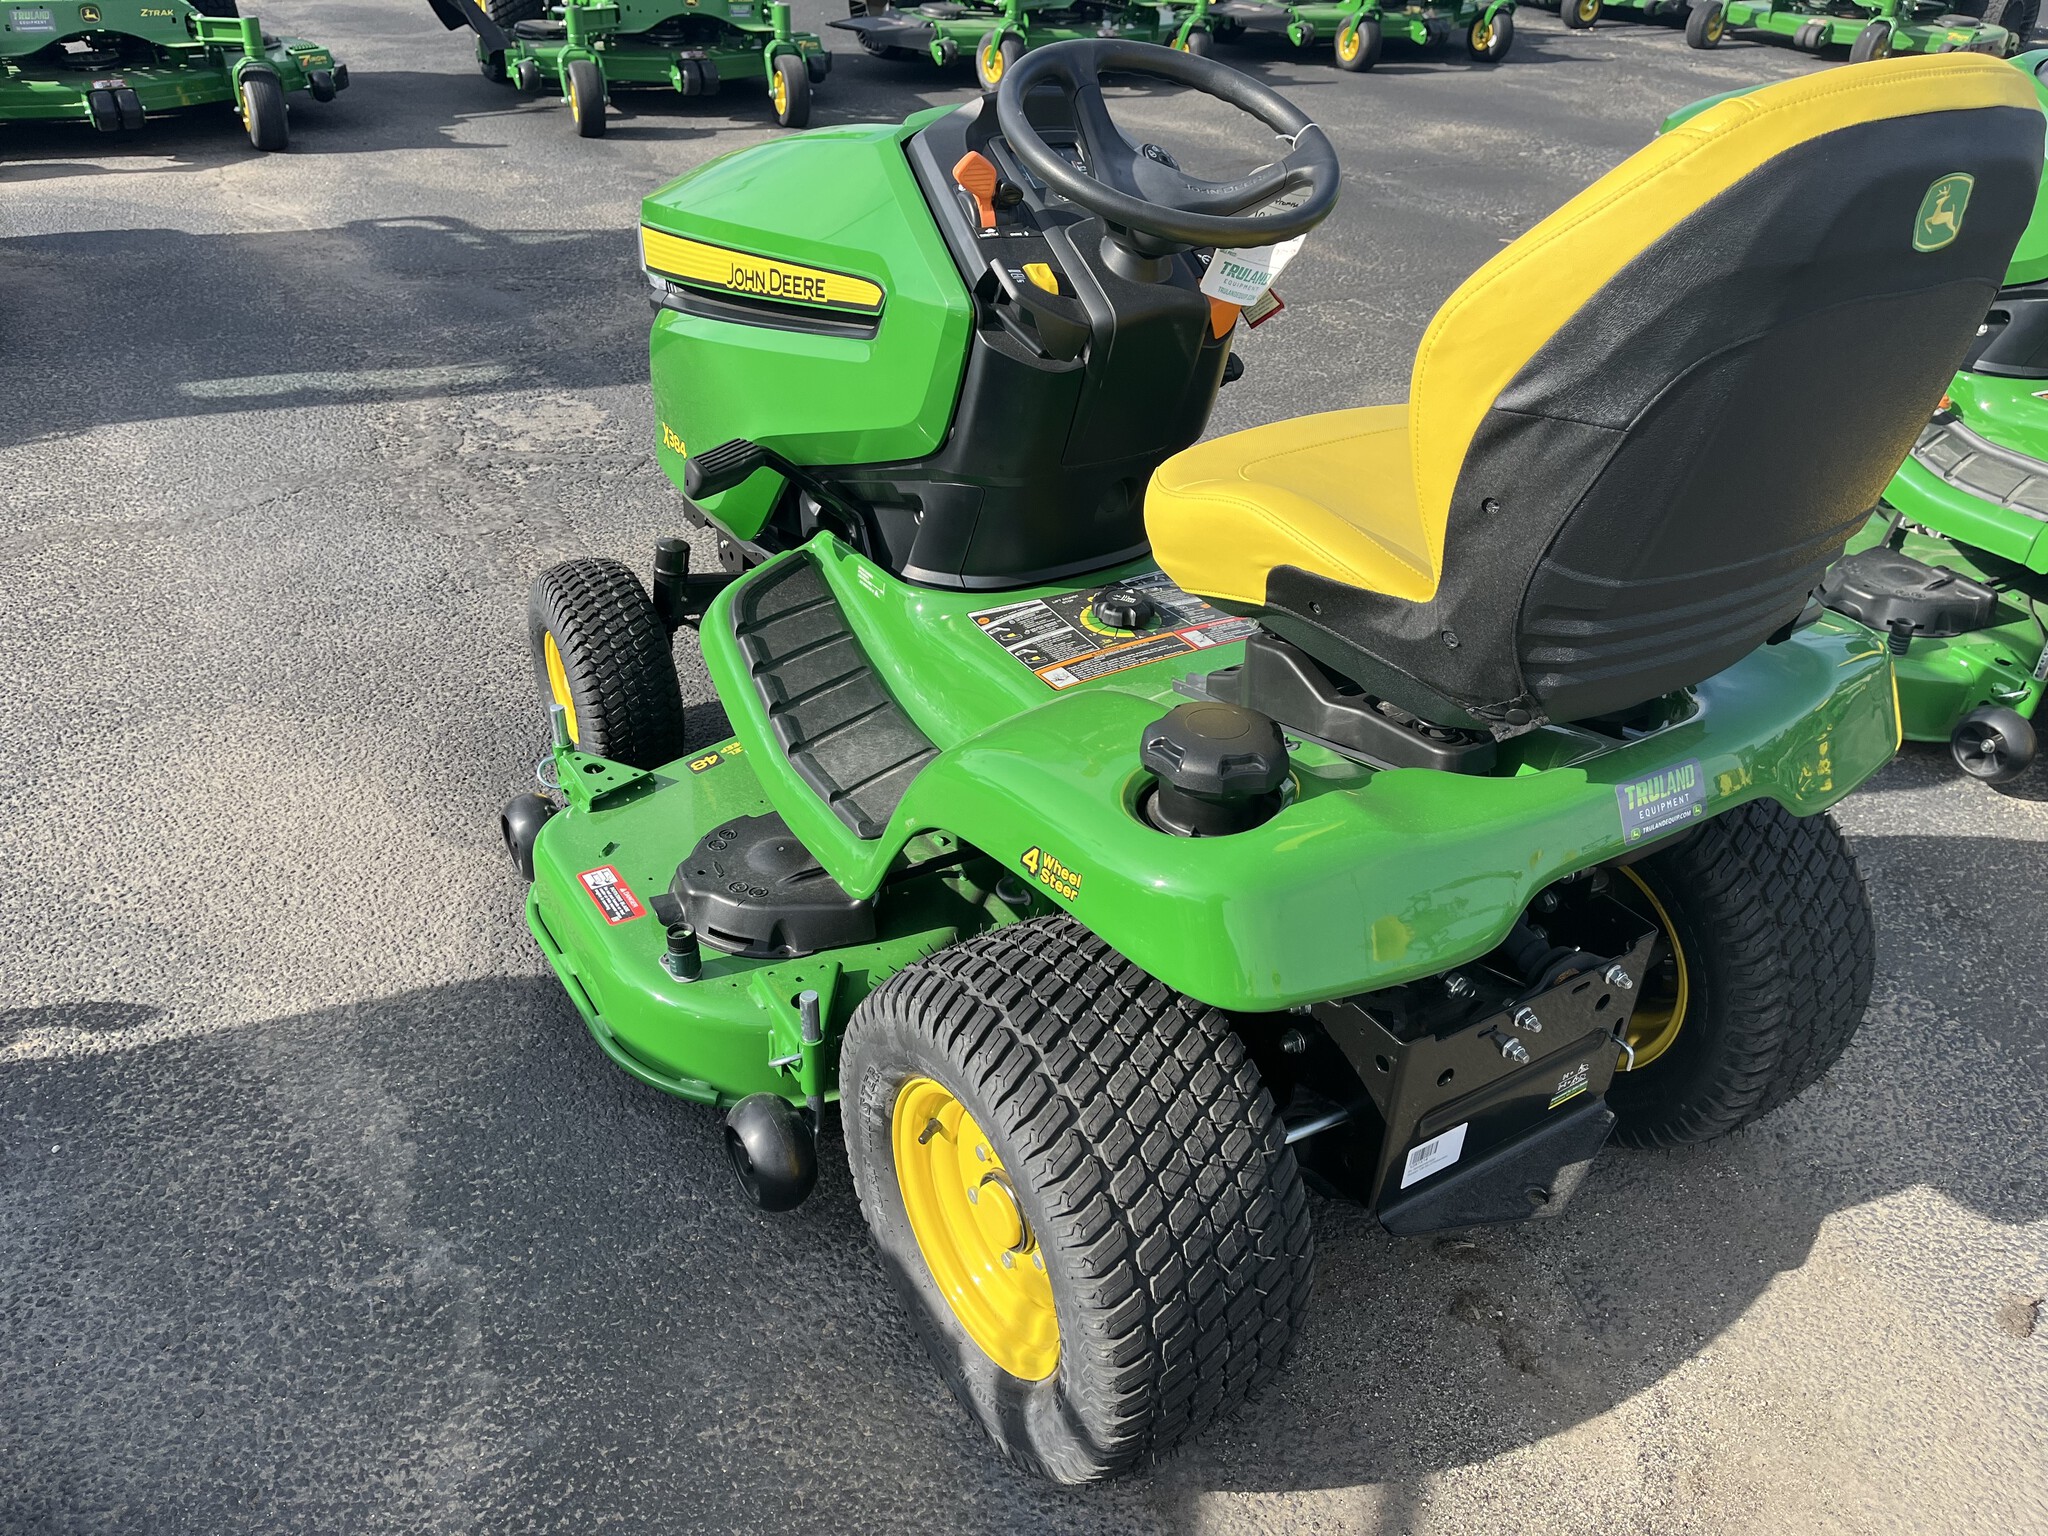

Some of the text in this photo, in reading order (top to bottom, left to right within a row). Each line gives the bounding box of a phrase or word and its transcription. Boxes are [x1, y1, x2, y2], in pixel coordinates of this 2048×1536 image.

[12, 11, 50, 20] TRULAND
[140, 8, 174, 17] ZTRAK
[726, 262, 827, 300] JOHN DEERE
[1220, 261, 1272, 286] TRULAND
[1223, 278, 1259, 291] EQUIPMENT
[690, 754, 719, 771] 48
[1624, 763, 1695, 811] TRULAND
[1639, 793, 1690, 820] EQUIPMENT
[1642, 809, 1692, 834] TRULANDEQUIP.COM
[1020, 845, 1083, 890] 4 Wheel
[1040, 866, 1079, 902] Steer
[623, 890, 639, 908] DANGER
